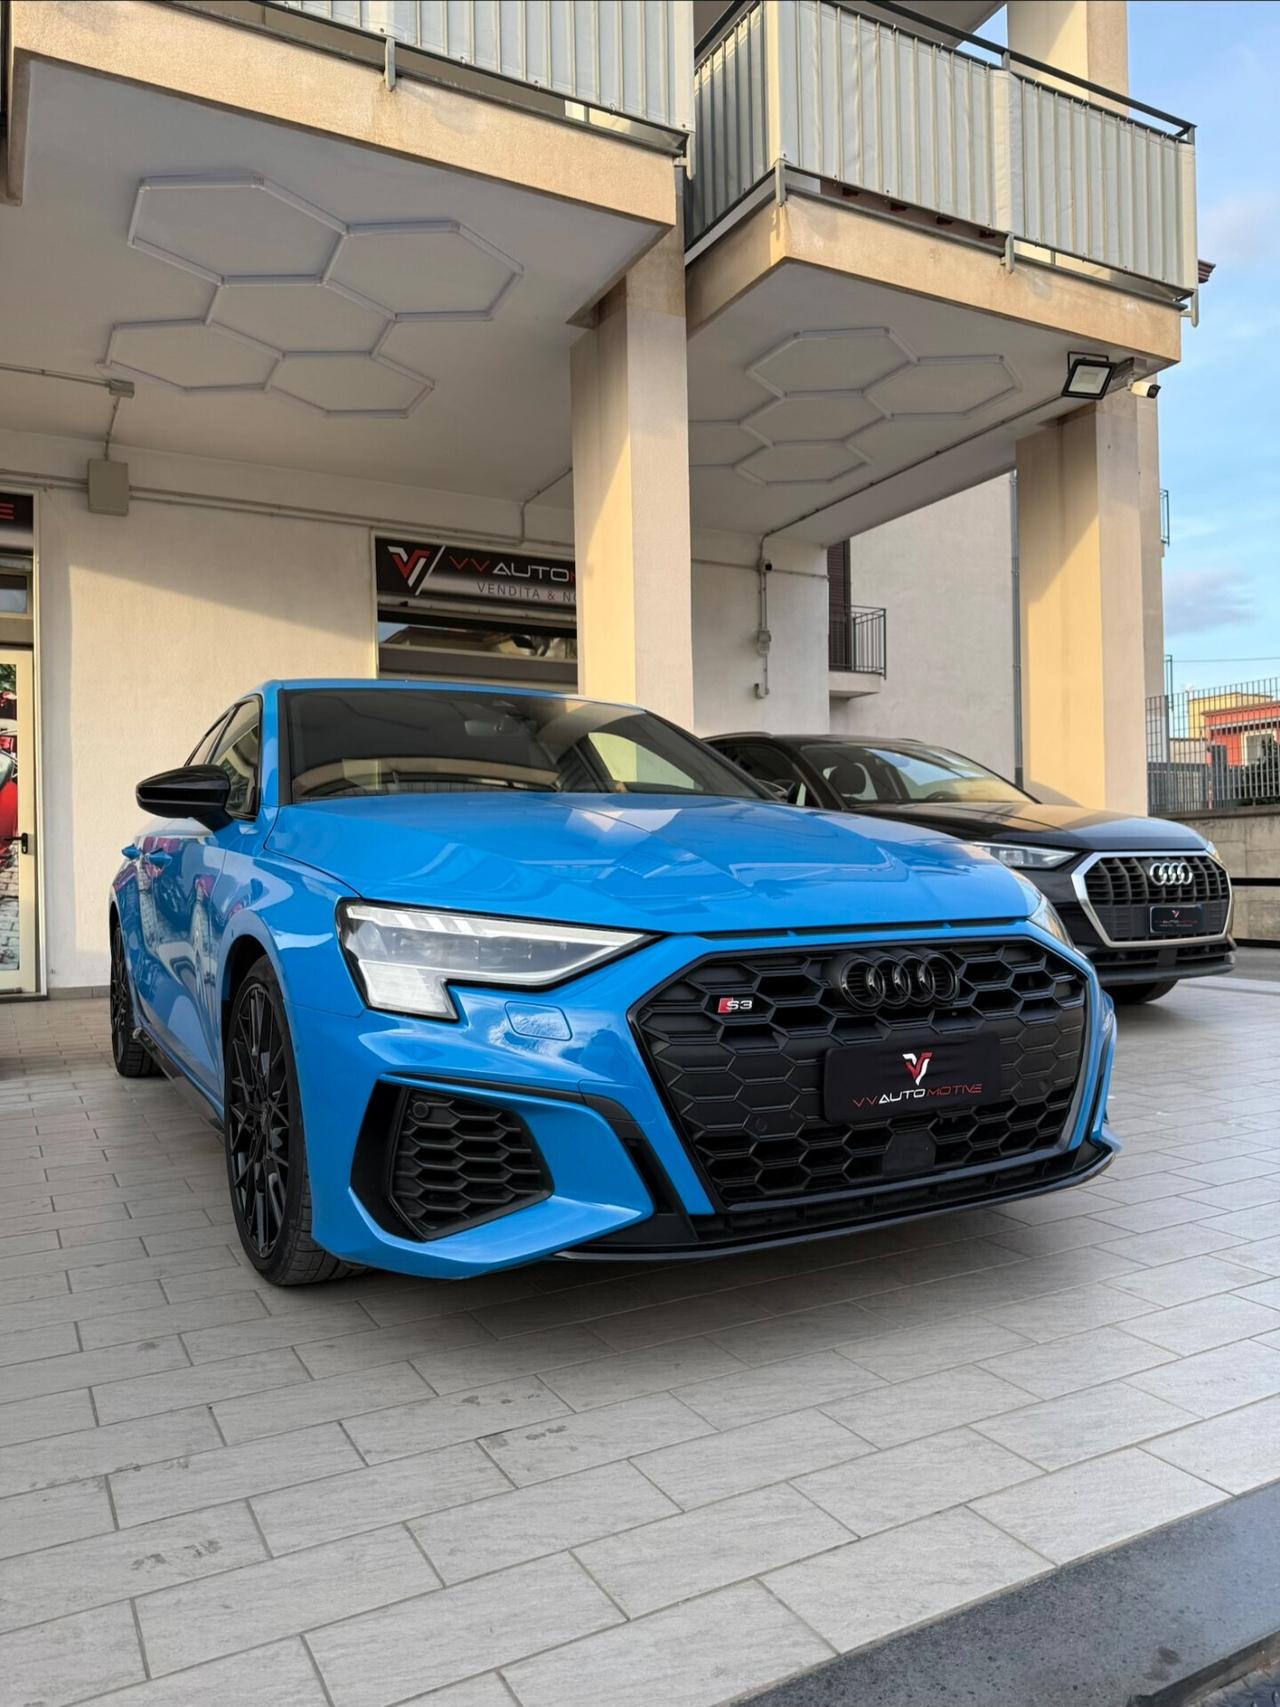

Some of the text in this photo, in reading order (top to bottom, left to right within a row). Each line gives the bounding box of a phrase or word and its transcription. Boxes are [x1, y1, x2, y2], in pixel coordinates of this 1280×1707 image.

[477, 582, 541, 600] VENDITA
[547, 591, 556, 601] &
[726, 1000, 753, 1010] S3
